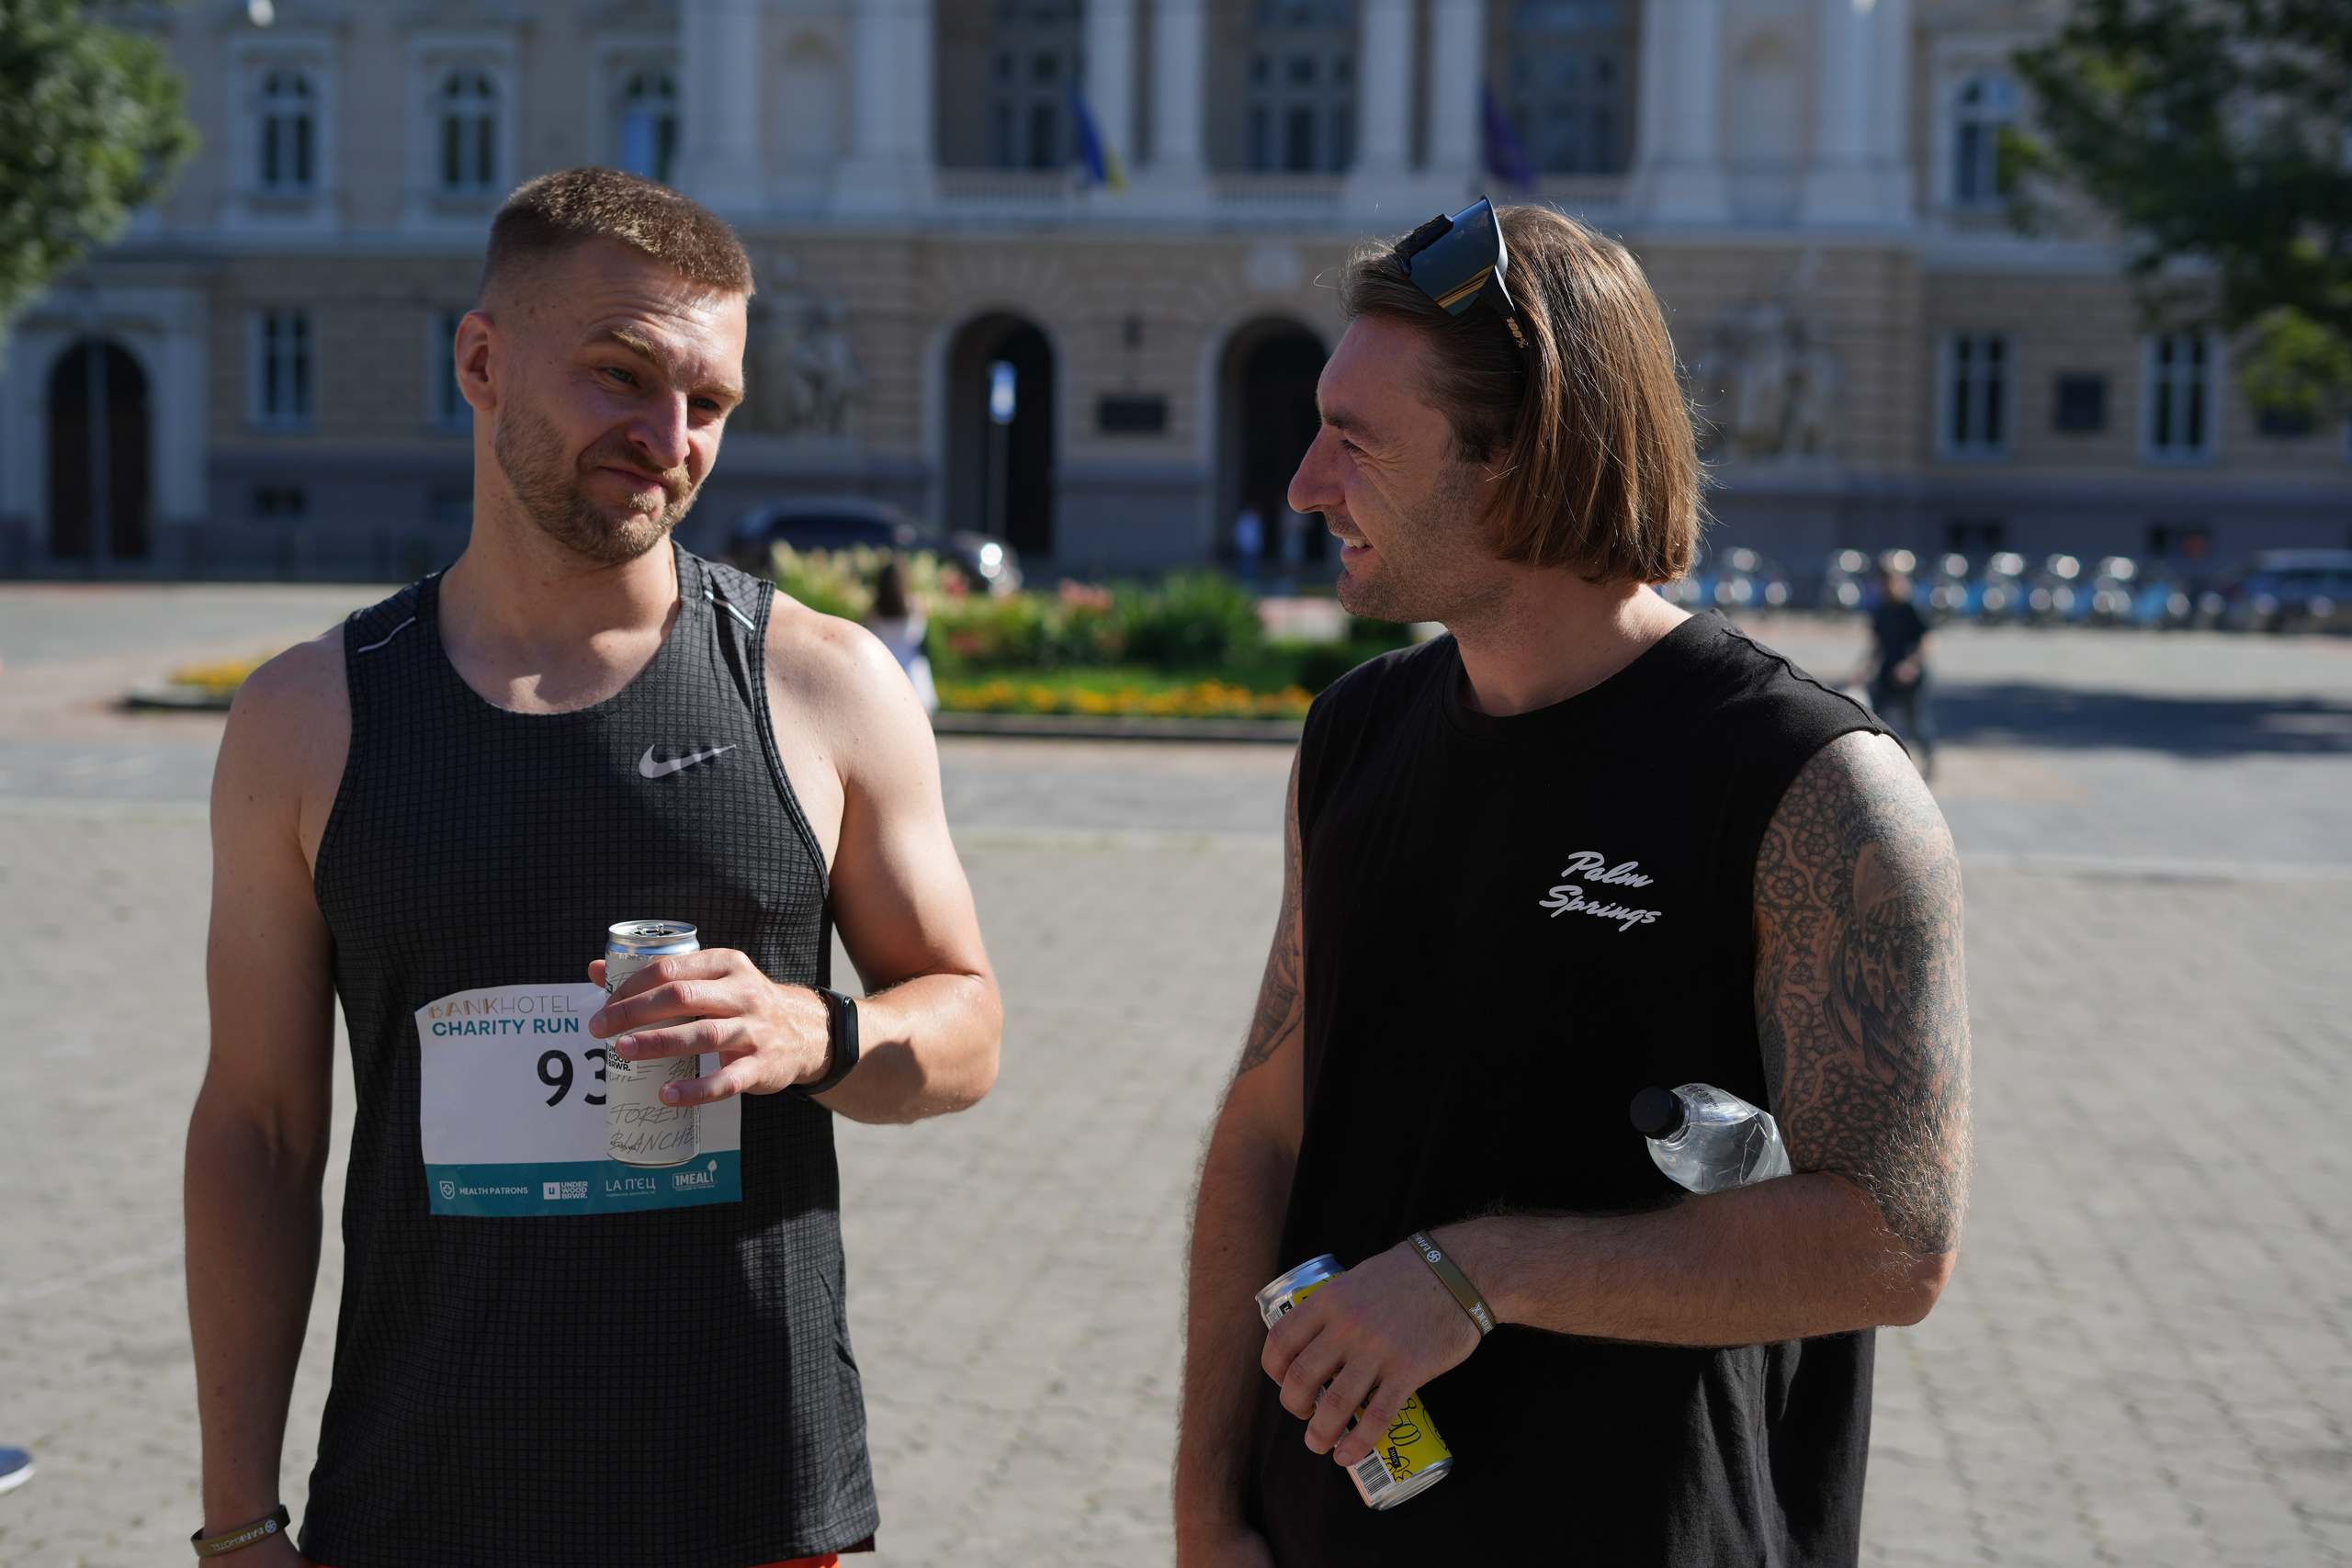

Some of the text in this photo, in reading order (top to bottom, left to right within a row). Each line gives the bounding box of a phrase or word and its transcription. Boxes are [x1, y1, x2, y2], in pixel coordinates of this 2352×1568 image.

[1506, 316, 1526, 349] 100%
[1561, 851, 1655, 888] Palm
[1538, 885, 1663, 932] Springs
[429, 995, 579, 1020] BANKHOTEL
[432, 1018, 579, 1036] CHARITY RUN
[537, 1048, 606, 1107] 93
[459, 1186, 528, 1195] HEALTH PATRONS
[605, 1179, 622, 1191] LA
[209, 1526, 265, 1551] BANKHOTEL
